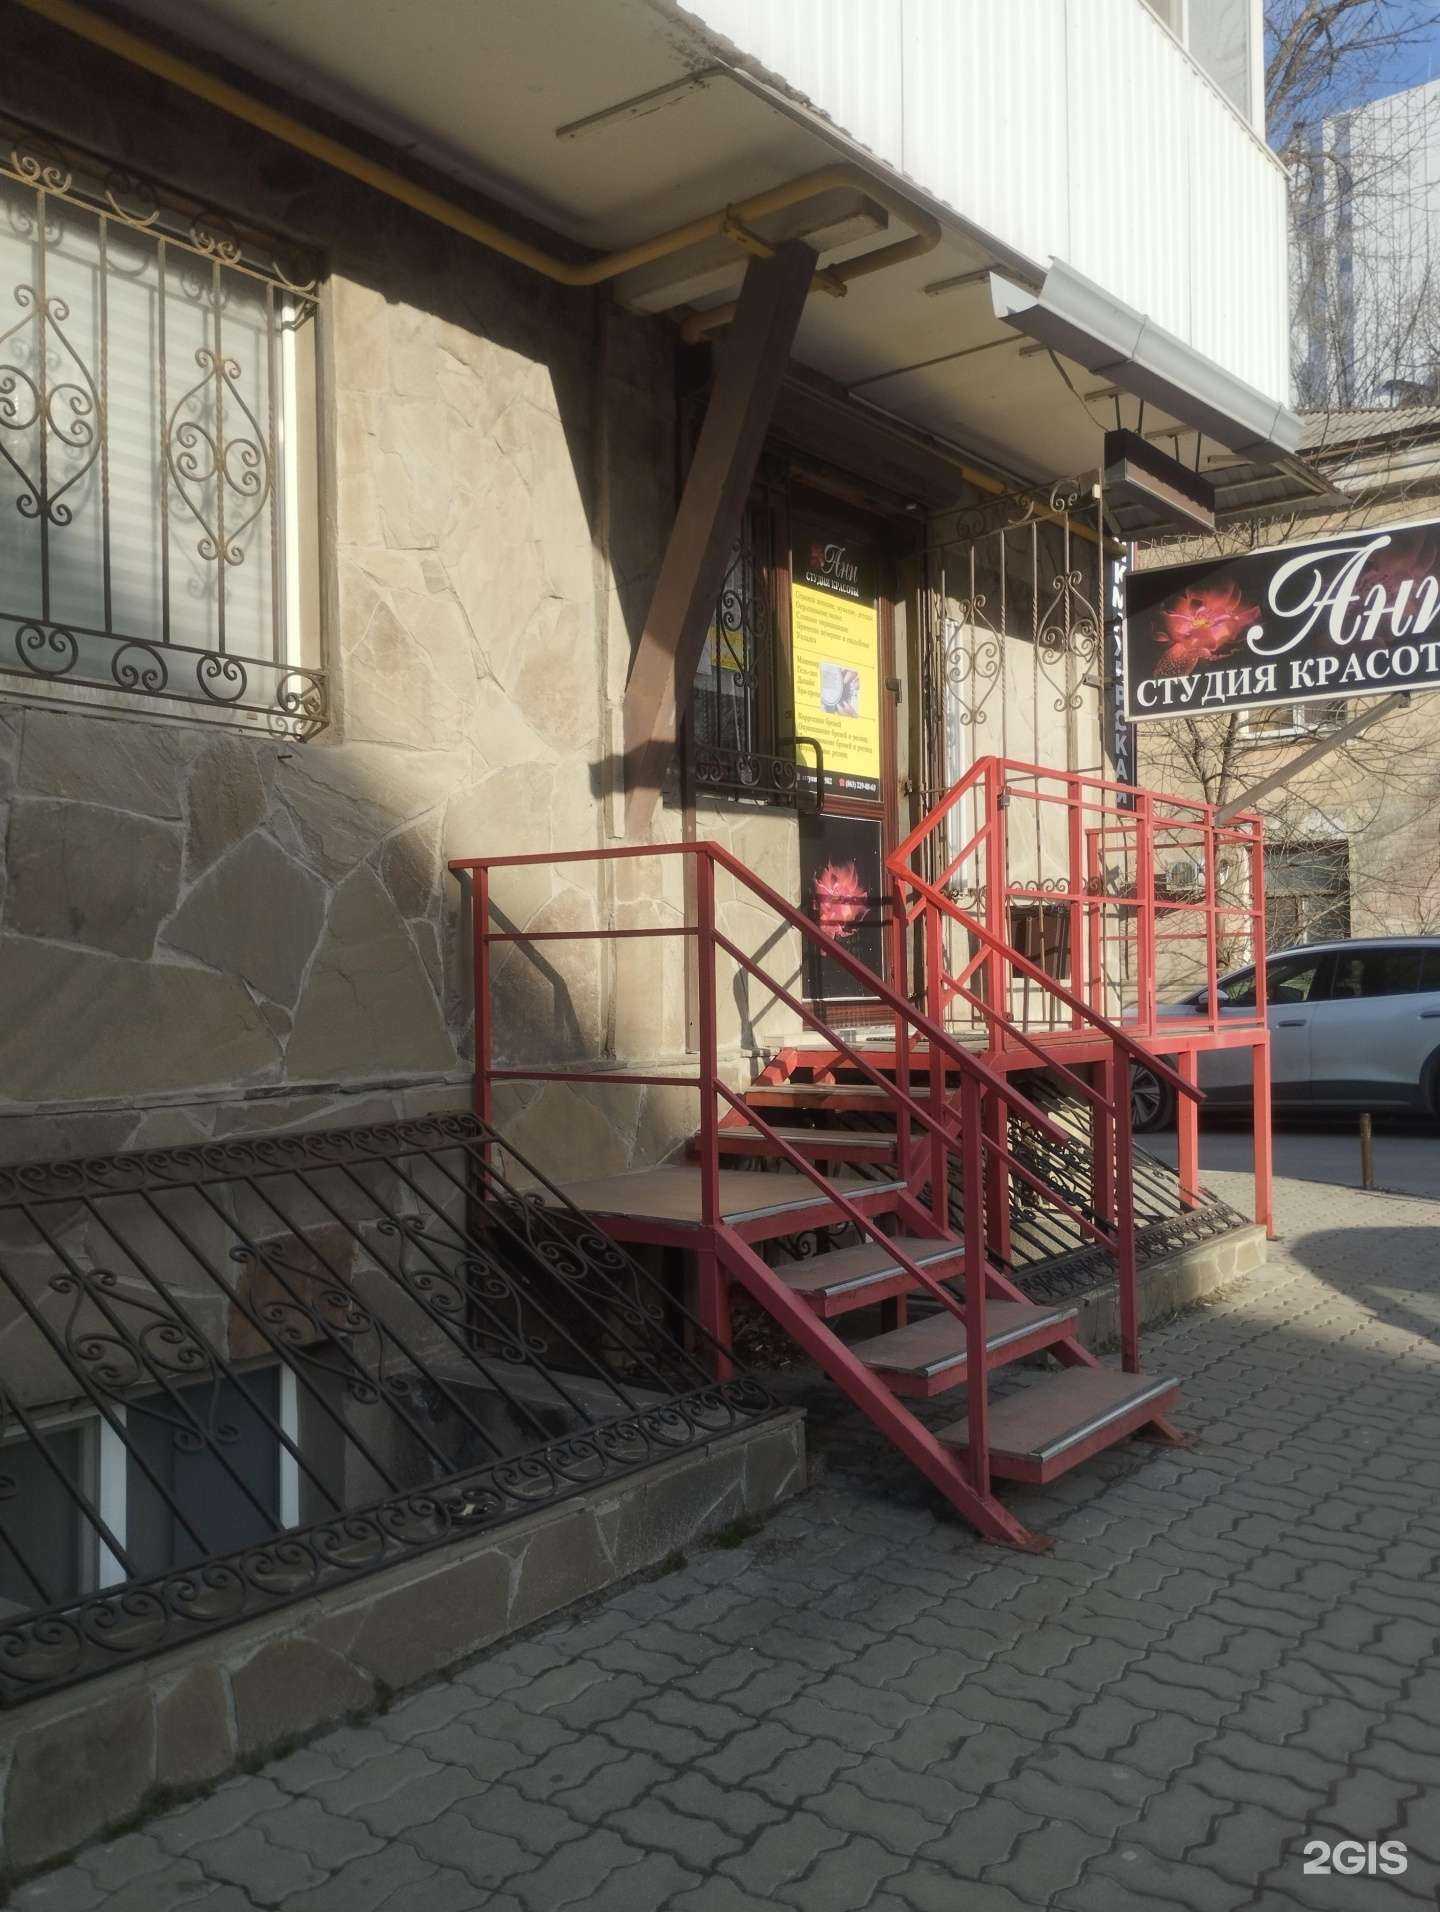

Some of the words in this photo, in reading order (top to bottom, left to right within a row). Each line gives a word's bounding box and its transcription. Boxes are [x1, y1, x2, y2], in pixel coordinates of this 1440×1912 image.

[819, 543, 858, 583] Ани
[806, 571, 831, 588] СТУДИЯ
[831, 578, 860, 597] КРАСОТЫ
[1136, 664, 1278, 706] СТУДИЯ
